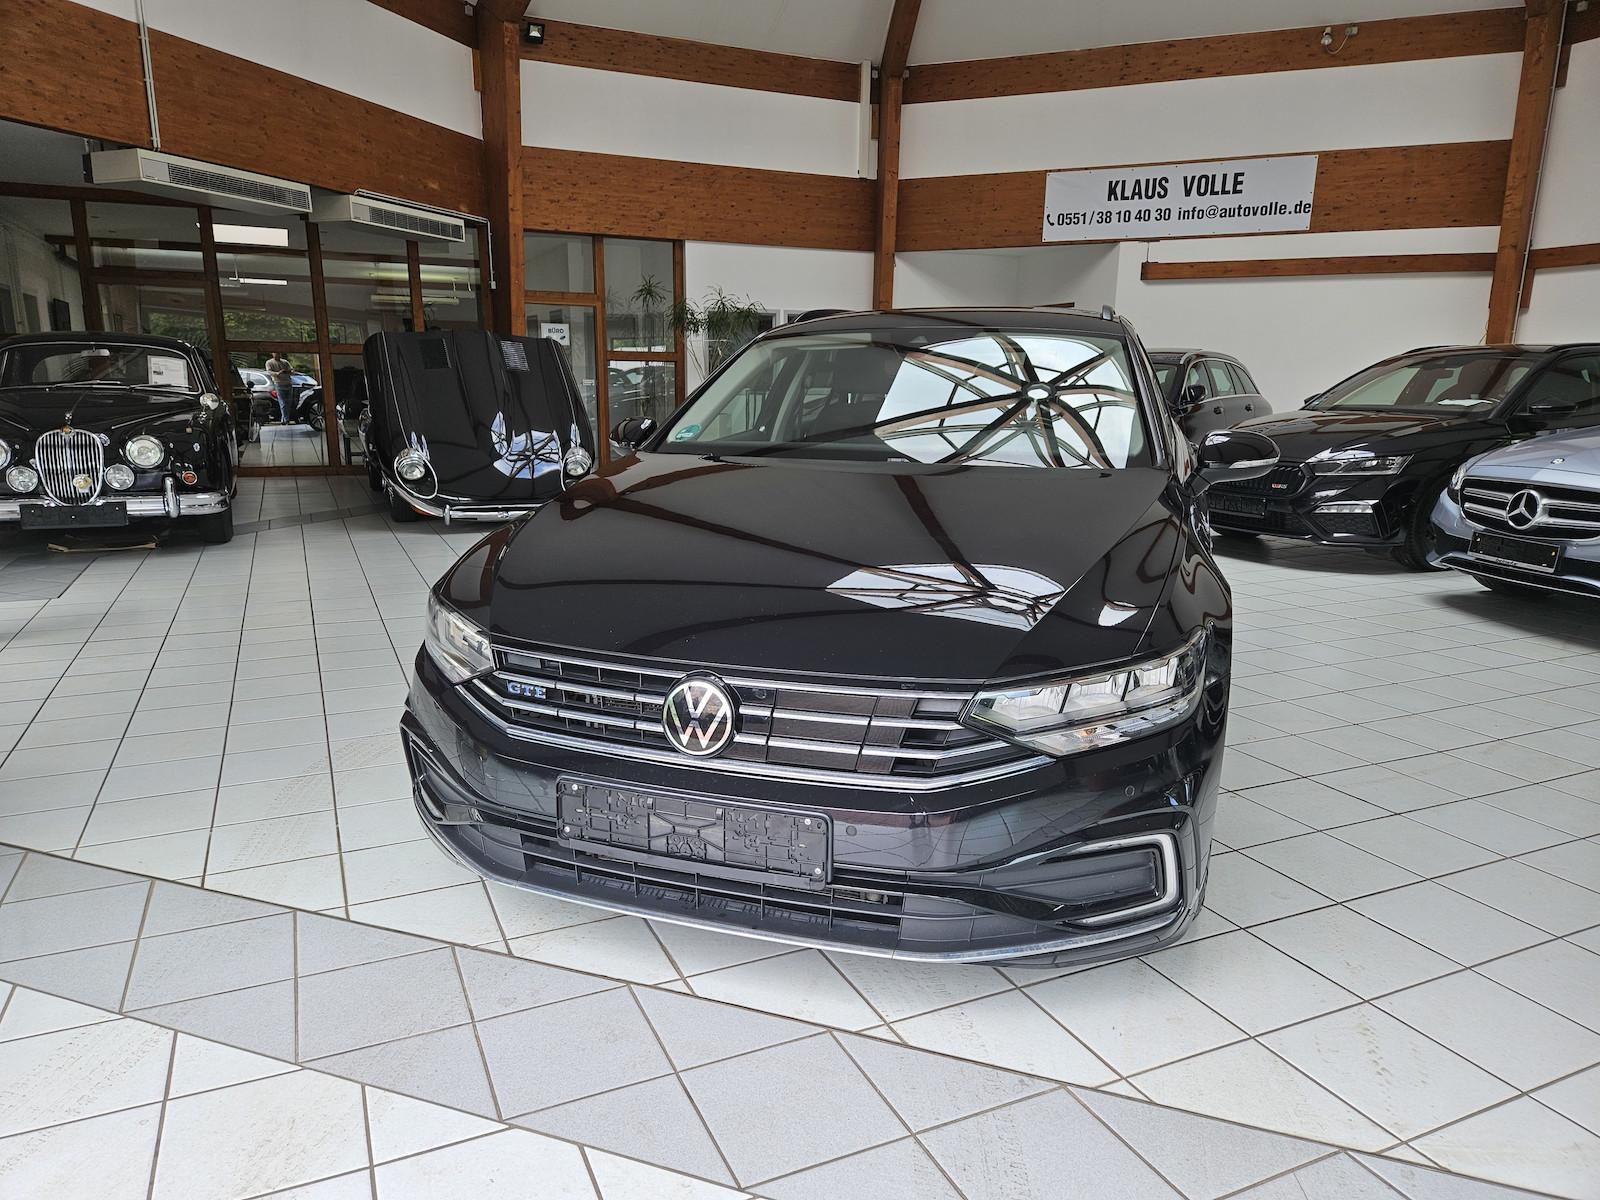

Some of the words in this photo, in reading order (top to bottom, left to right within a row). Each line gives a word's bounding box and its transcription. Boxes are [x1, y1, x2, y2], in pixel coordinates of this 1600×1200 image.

[1107, 177, 1169, 202] KLAUS
[1183, 172, 1245, 197] VOLLE
[1115, 209, 1132, 223] 10
[1134, 208, 1152, 222] 40
[1154, 207, 1172, 221] 30
[1178, 200, 1312, 220] info@autovolle.de
[508, 682, 546, 699] GTE
